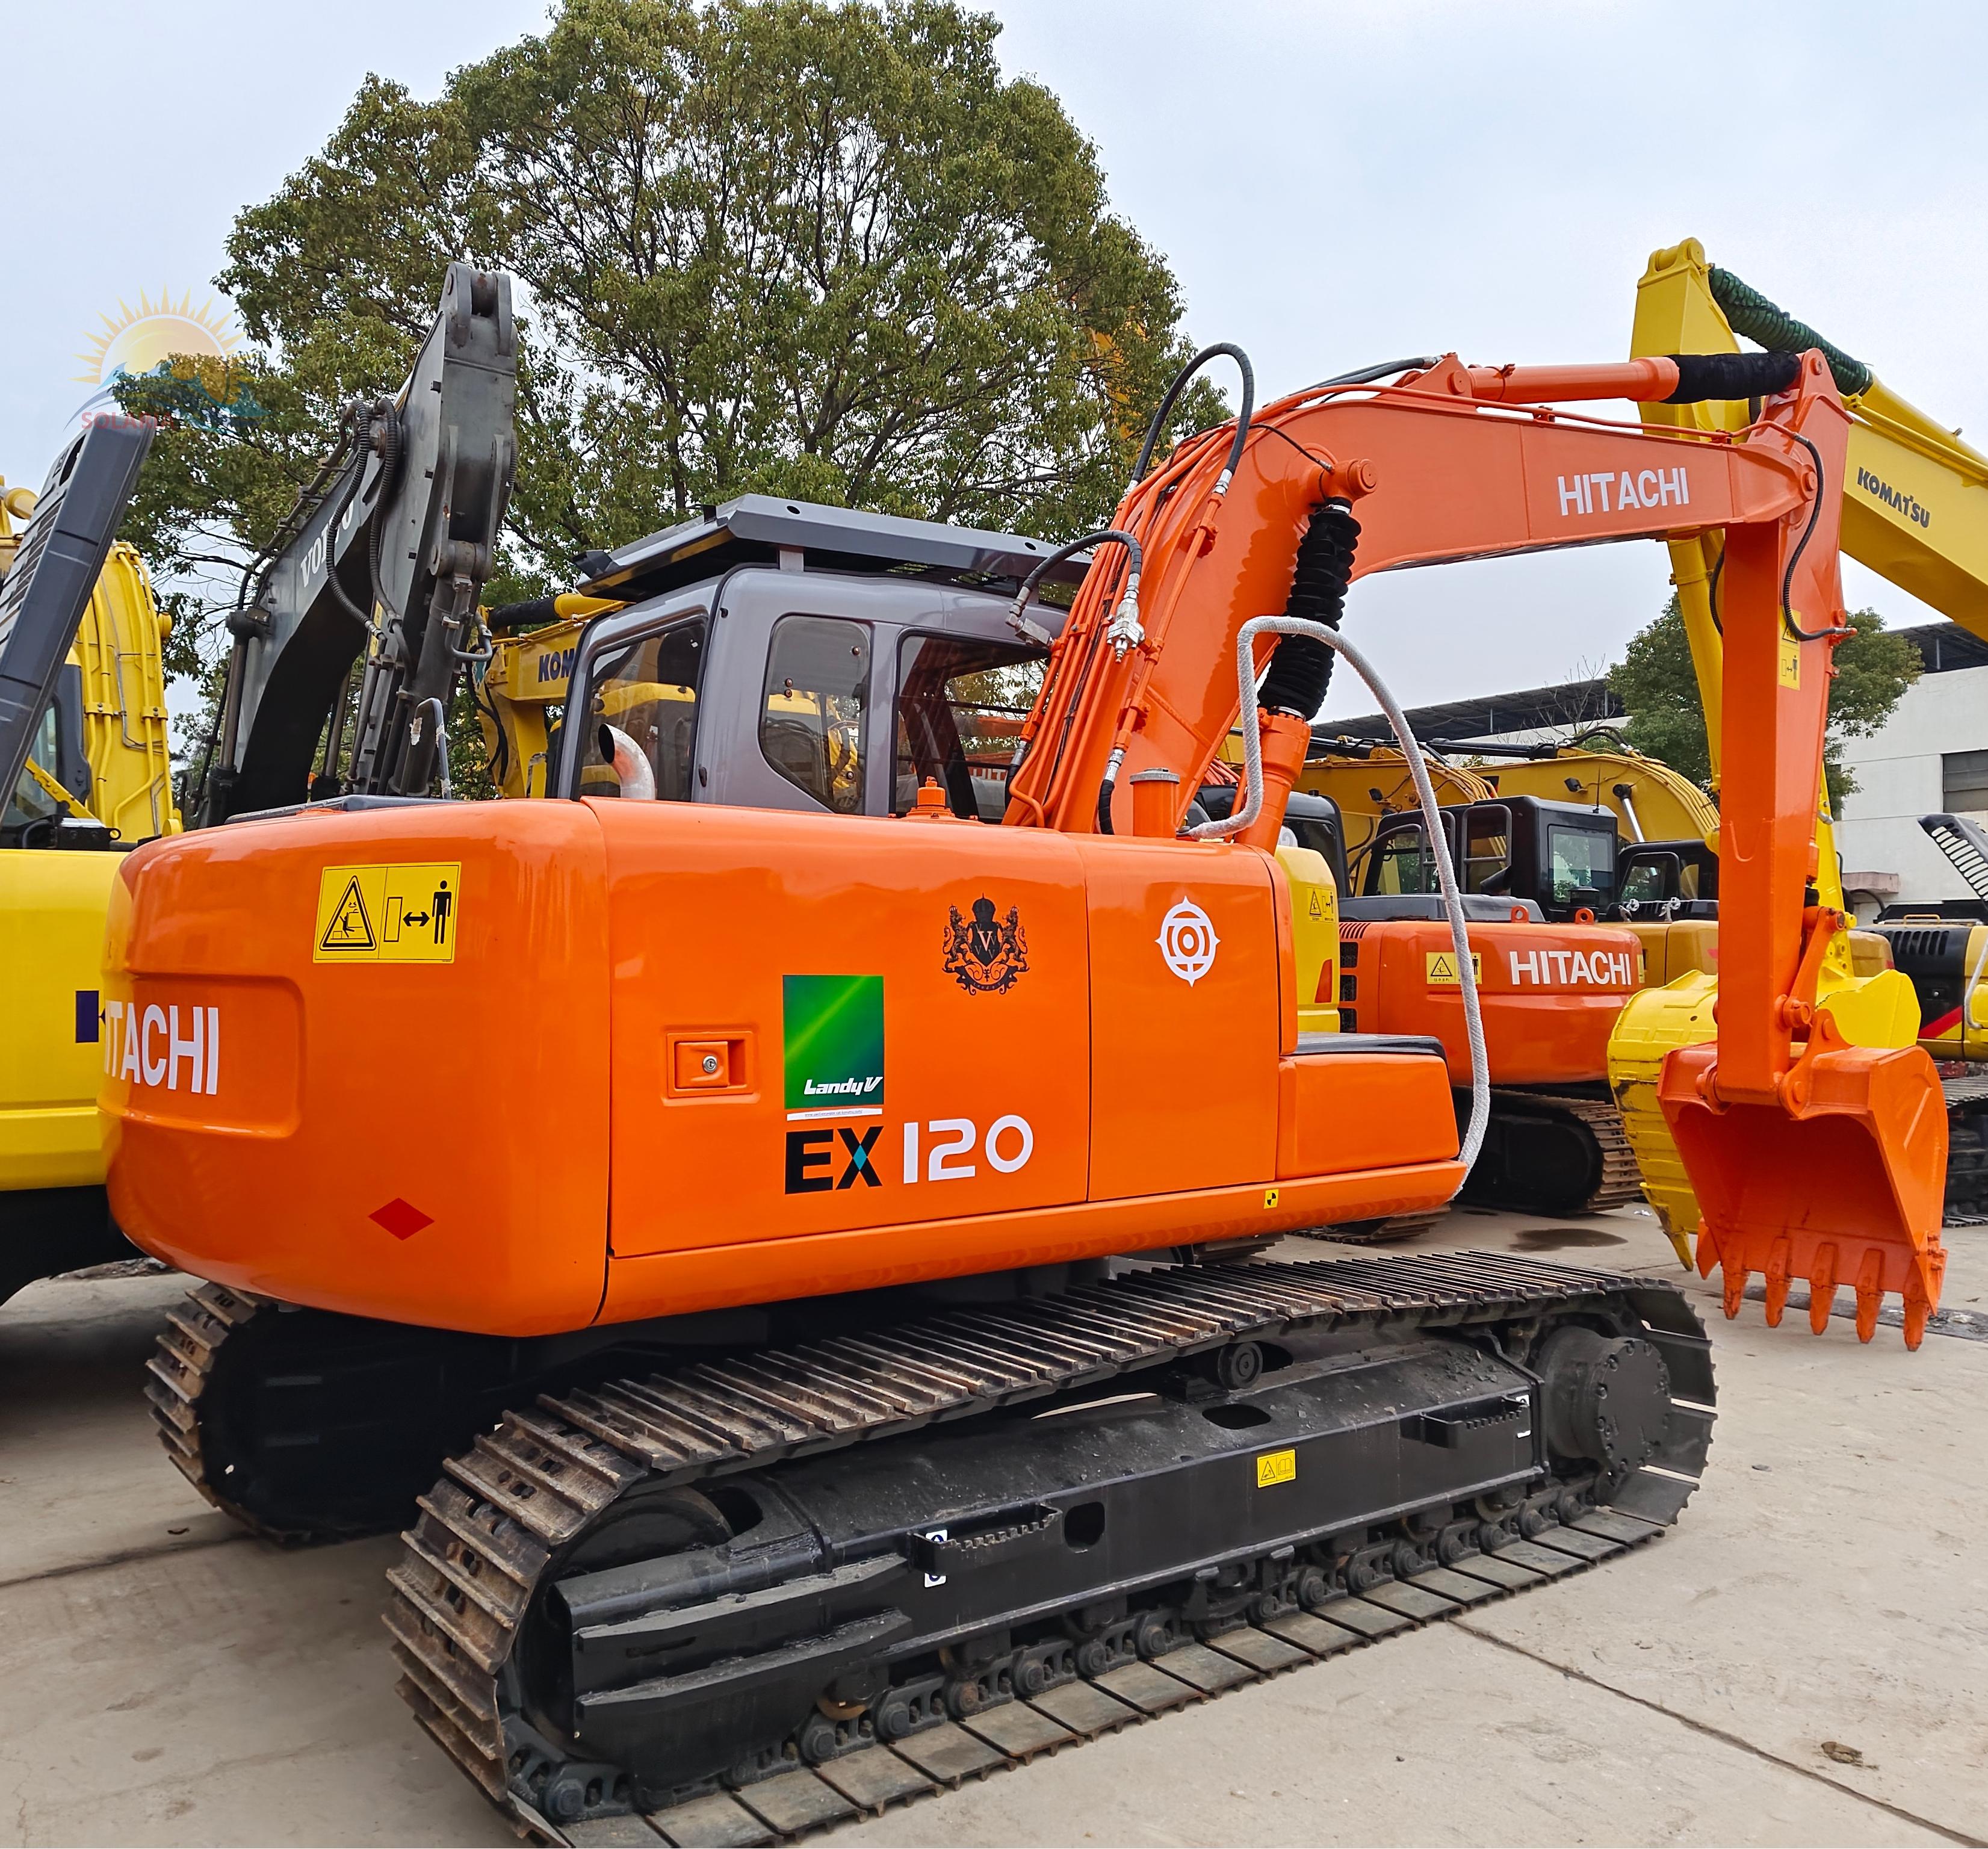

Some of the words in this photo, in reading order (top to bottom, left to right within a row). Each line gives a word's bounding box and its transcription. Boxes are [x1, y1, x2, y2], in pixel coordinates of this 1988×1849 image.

[1558, 467, 1690, 516] HITACHI
[1857, 466, 1930, 528] KOMATSU
[300, 500, 354, 587] VOLO
[977, 931, 993, 952] V
[1510, 950, 1632, 985] HITACHI
[785, 1126, 884, 1195] EX
[903, 1115, 1034, 1184] 120
